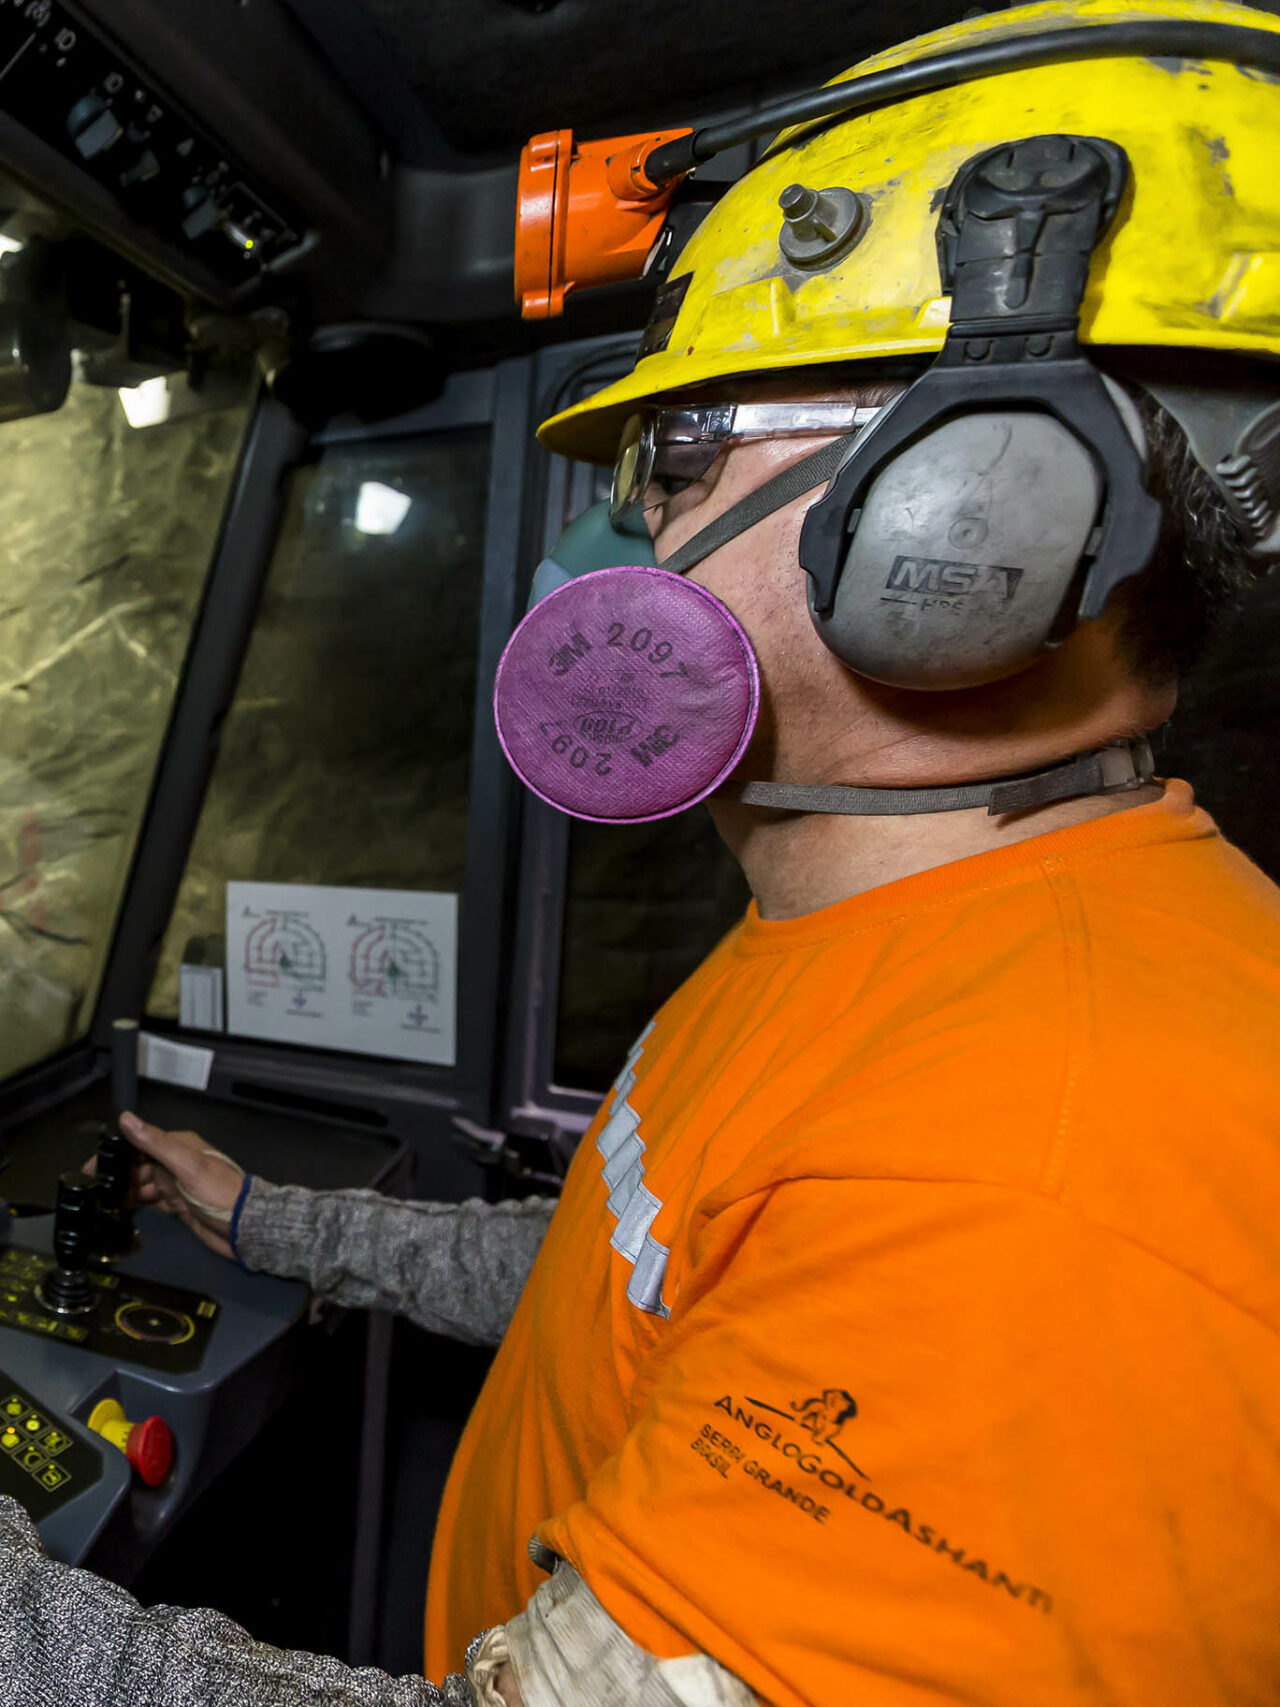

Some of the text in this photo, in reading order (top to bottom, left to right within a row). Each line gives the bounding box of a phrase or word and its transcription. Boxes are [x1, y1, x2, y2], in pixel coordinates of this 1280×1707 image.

[893, 560, 1009, 598] MSA
[548, 631, 593, 677] 3M
[538, 720, 680, 777] 3M 2097
[742, 1460, 831, 1524] GRANDE
